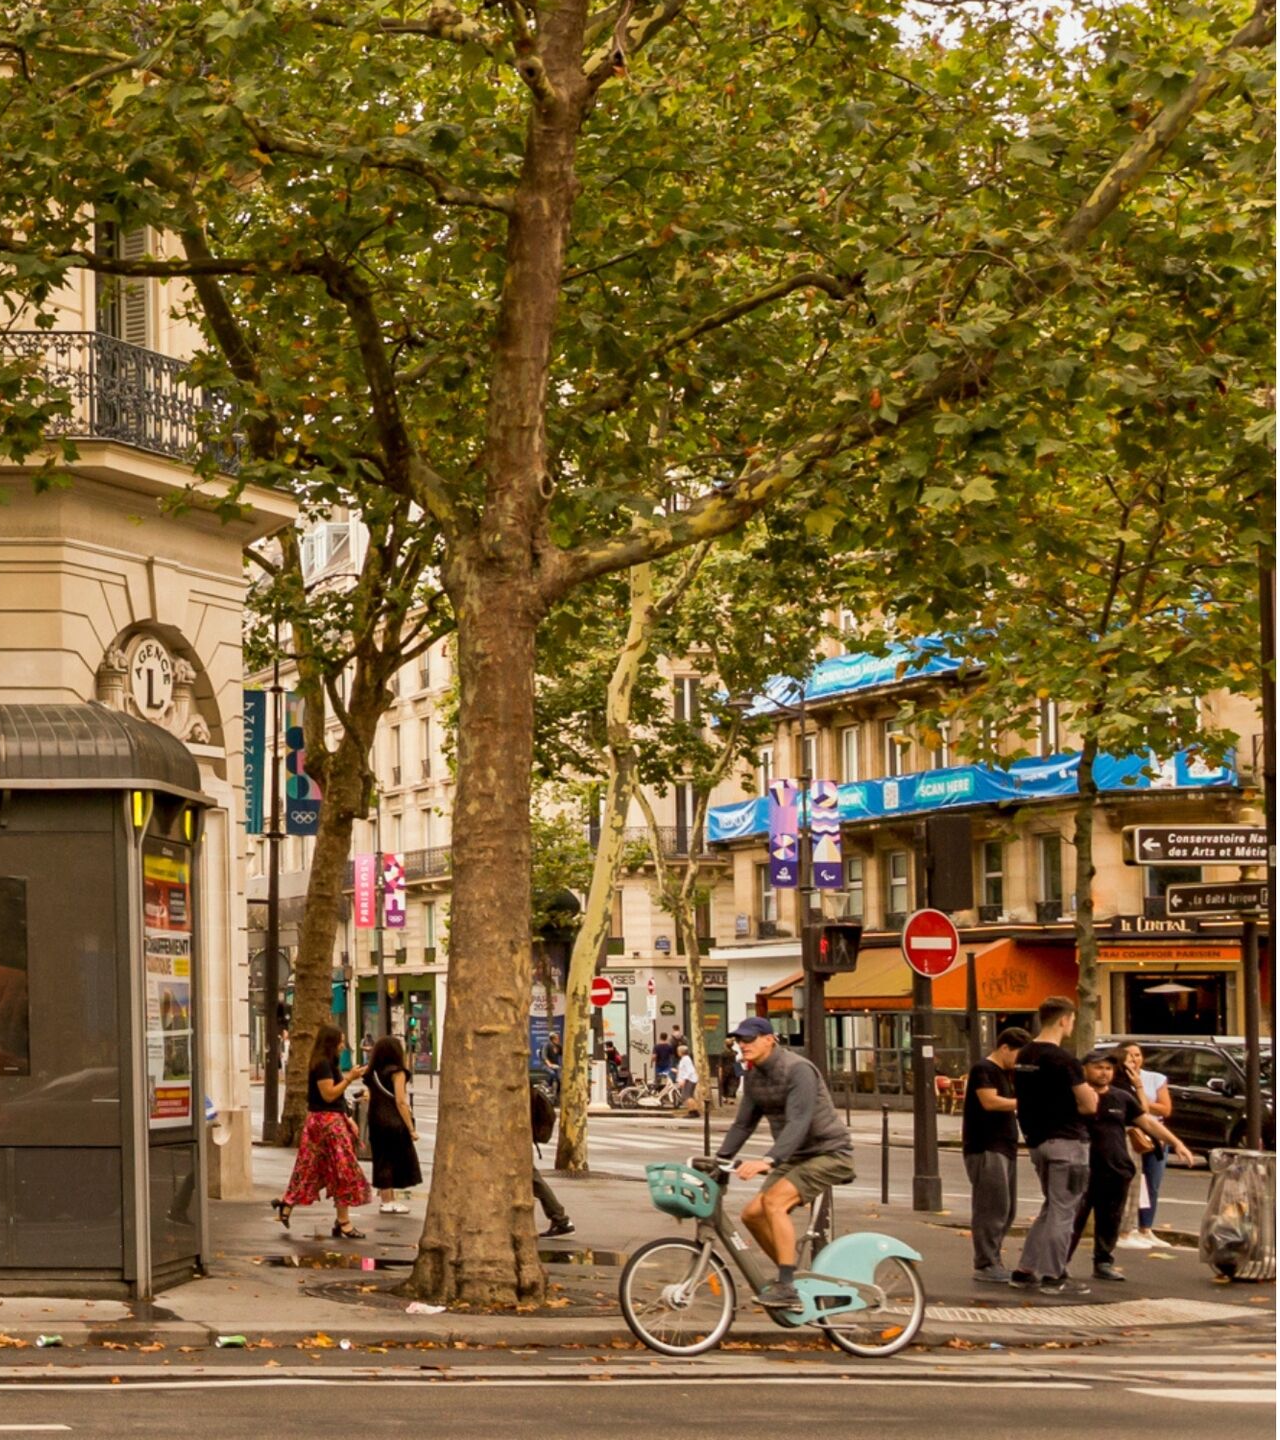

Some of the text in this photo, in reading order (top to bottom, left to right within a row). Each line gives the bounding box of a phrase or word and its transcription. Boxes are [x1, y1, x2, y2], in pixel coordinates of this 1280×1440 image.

[135, 644, 171, 685] AGENCE
[146, 668, 164, 710] L
[920, 778, 969, 797] SCAN HERE
[1168, 833, 1245, 844] Conservatoire
[1168, 846, 1266, 857] des Arts et Métie
[360, 891, 369, 923] PARIS
